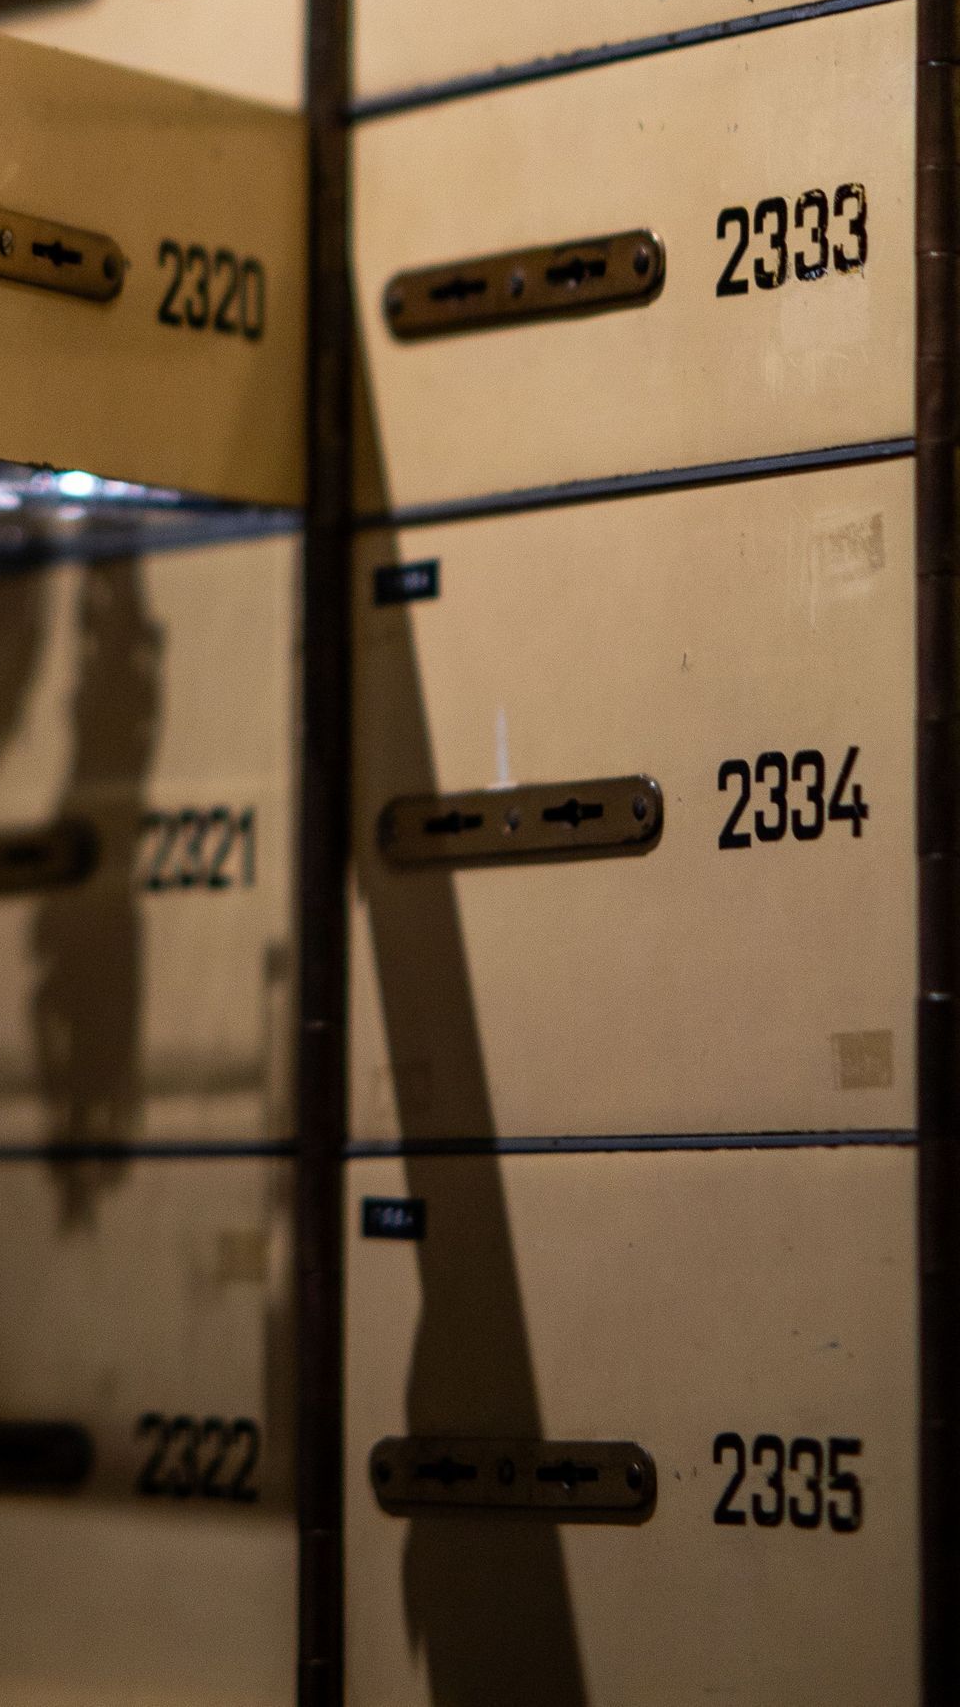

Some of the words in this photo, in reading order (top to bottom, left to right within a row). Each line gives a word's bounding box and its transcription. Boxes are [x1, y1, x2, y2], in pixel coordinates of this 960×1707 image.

[716, 184, 868, 297] 2333
[157, 240, 265, 344] 2320
[718, 747, 868, 850] 2334
[138, 807, 256, 893] 2321
[135, 1413, 262, 1507] 2322
[713, 1433, 863, 1534] 2335
